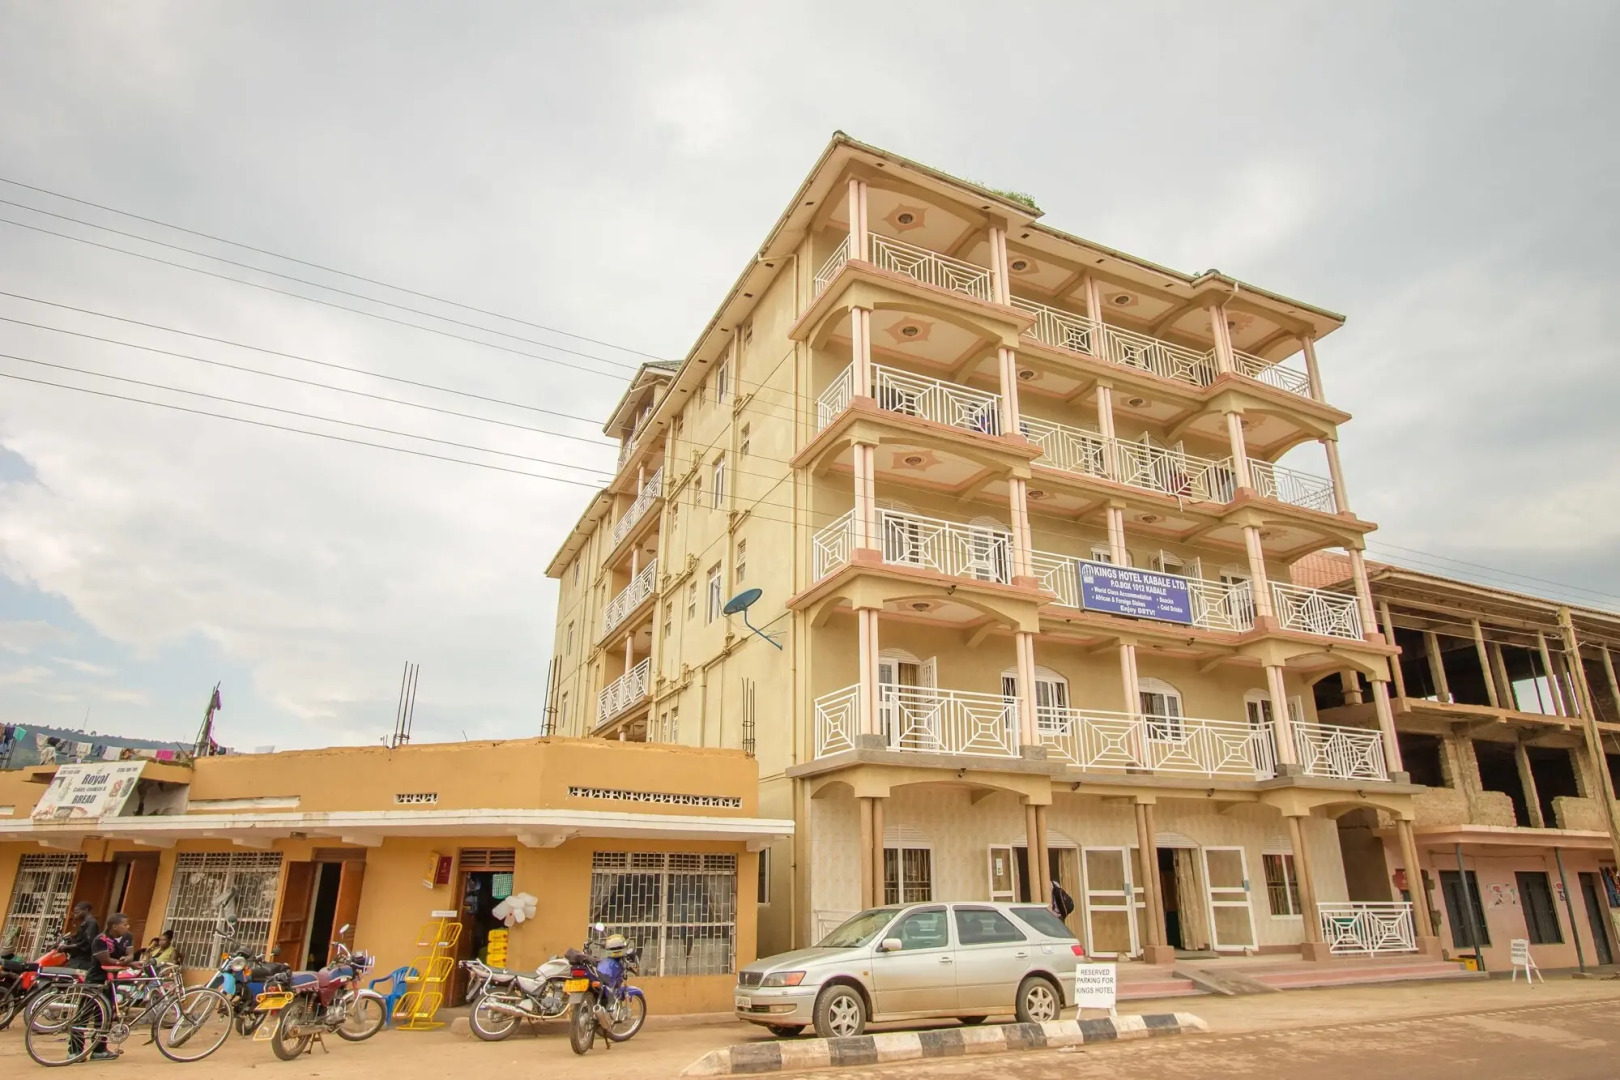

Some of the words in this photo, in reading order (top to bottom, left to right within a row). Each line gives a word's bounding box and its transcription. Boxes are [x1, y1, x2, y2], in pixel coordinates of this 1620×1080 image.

[1094, 566, 1117, 578] KINGS
[1118, 571, 1142, 583] HOTEL
[1143, 574, 1171, 587] KABALE
[1172, 580, 1186, 590] LTD.
[1146, 585, 1166, 595] KABALE
[1095, 594, 1111, 602] African
[1120, 605, 1137, 614] Enjoy
[81, 773, 110, 785] Royal
[71, 794, 97, 804] BREAD
